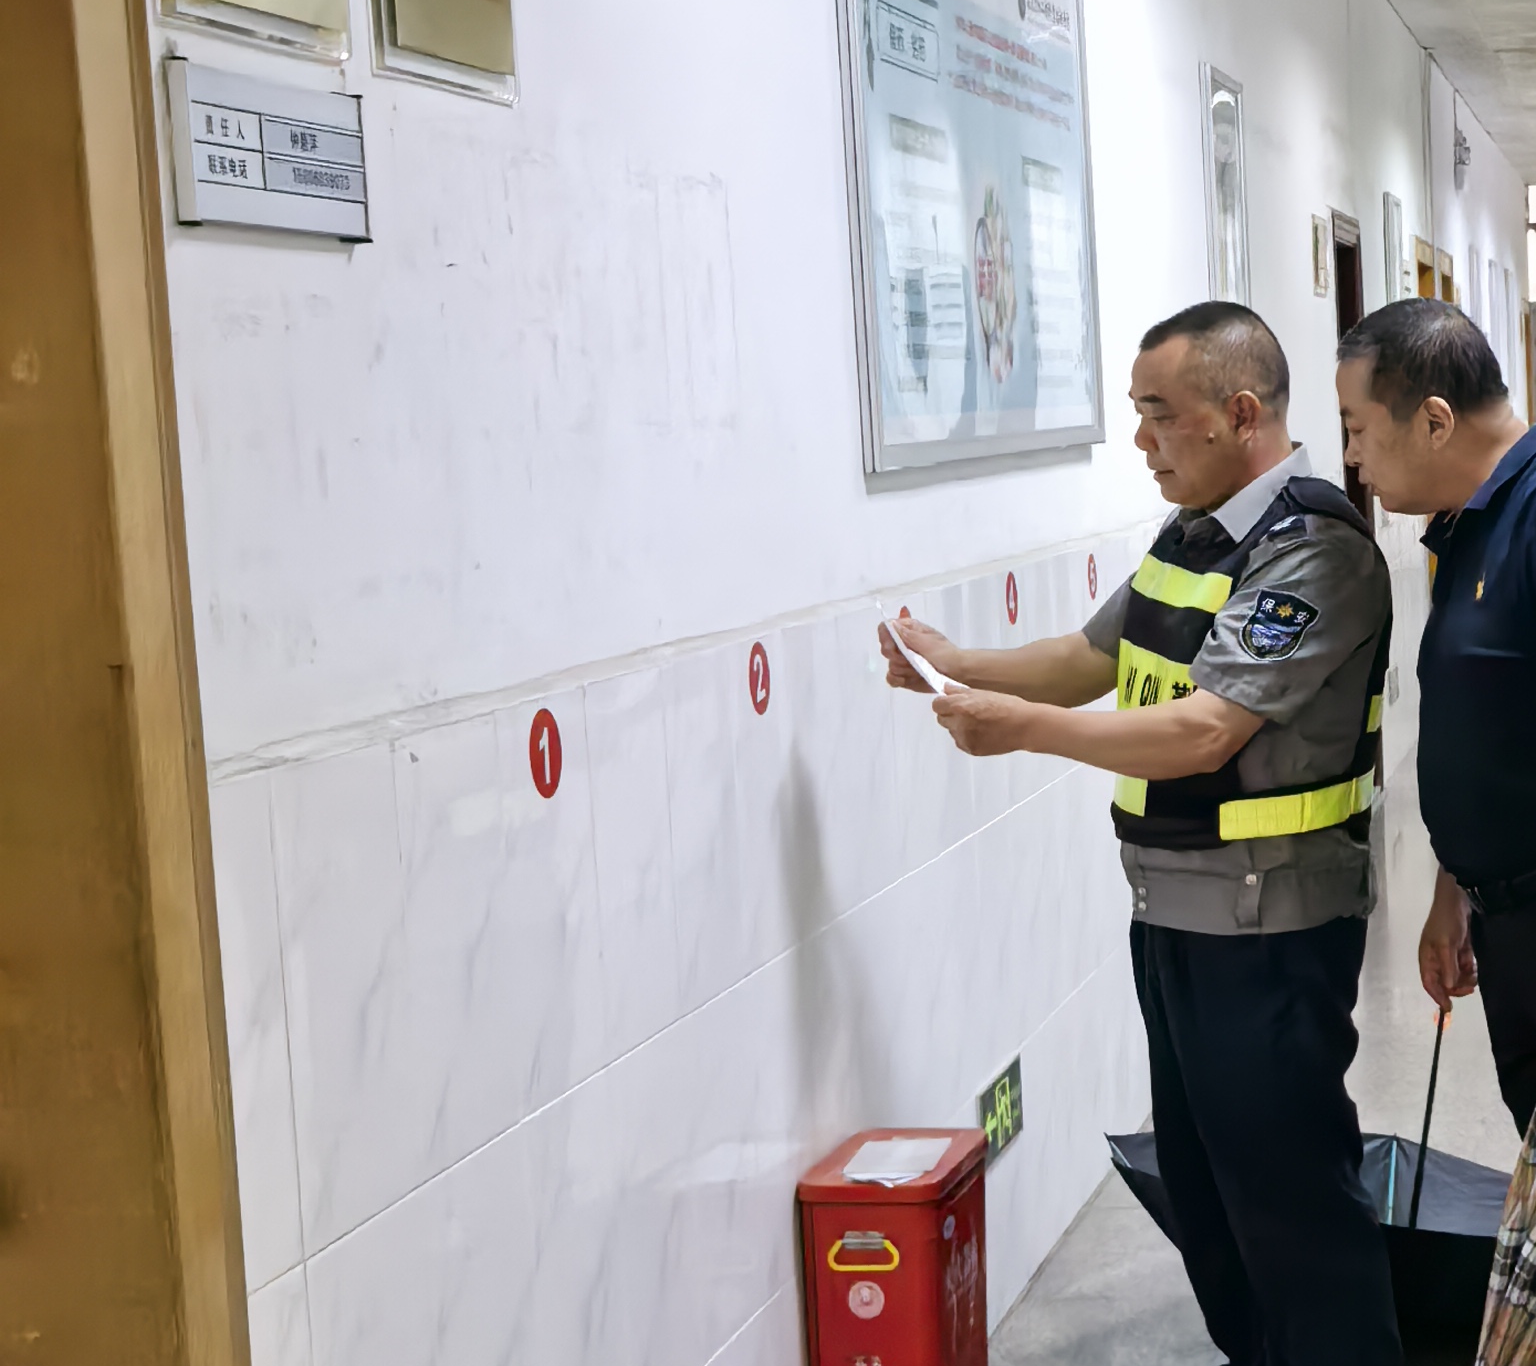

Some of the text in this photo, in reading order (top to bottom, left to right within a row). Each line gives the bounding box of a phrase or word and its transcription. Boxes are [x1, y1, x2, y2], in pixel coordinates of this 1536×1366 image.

[205, 114, 245, 141] 责任人
[207, 154, 248, 180] 联系电话
